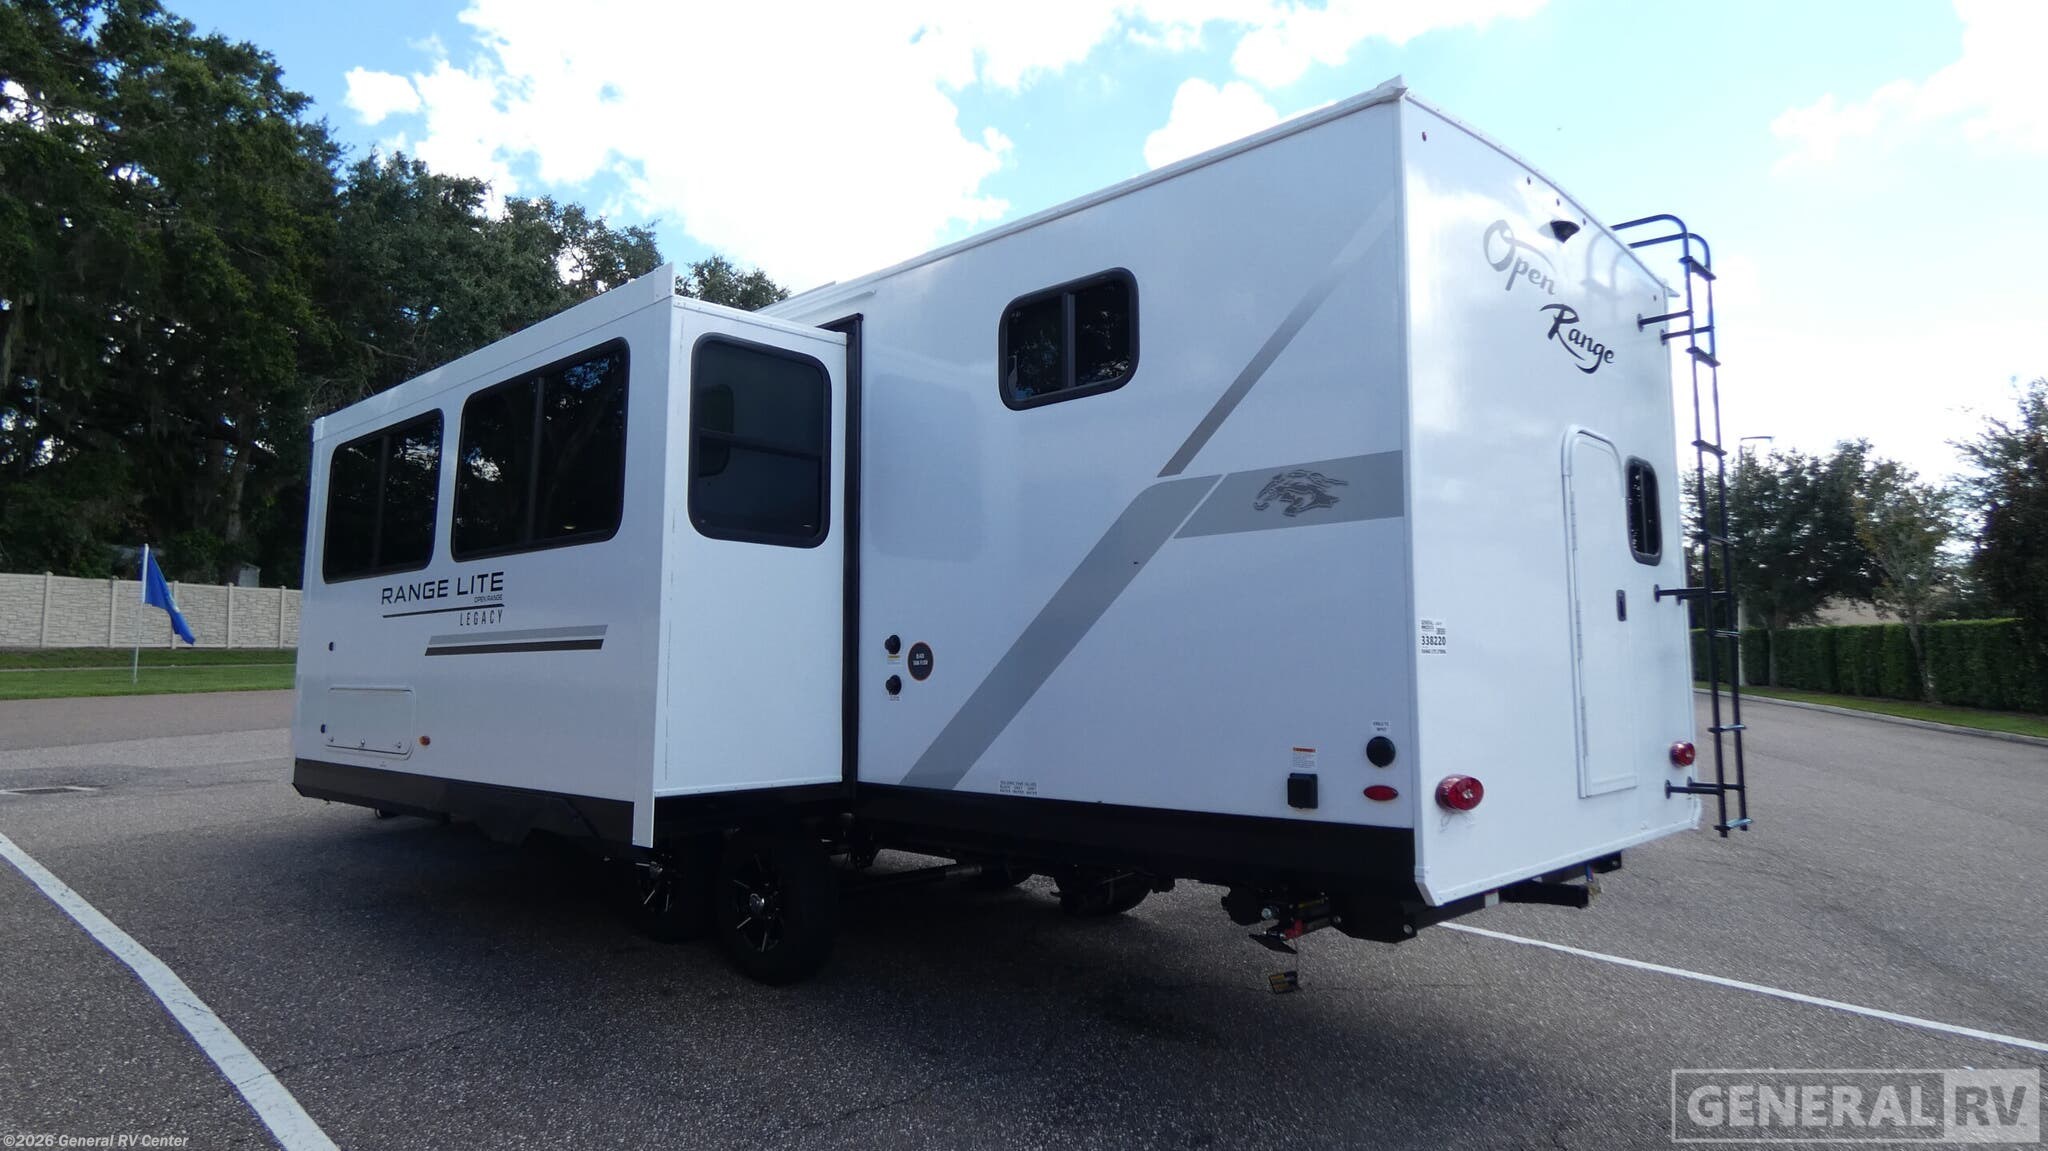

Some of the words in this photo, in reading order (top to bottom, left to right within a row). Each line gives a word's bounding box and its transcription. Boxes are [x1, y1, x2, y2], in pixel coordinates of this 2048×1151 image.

[1483, 219, 1556, 295] Open
[1539, 303, 1615, 374] Range
[381, 579, 449, 605] RANGE
[457, 571, 504, 596] LITE
[459, 609, 503, 626] LEGACY
[1421, 635, 1447, 646] 338220
